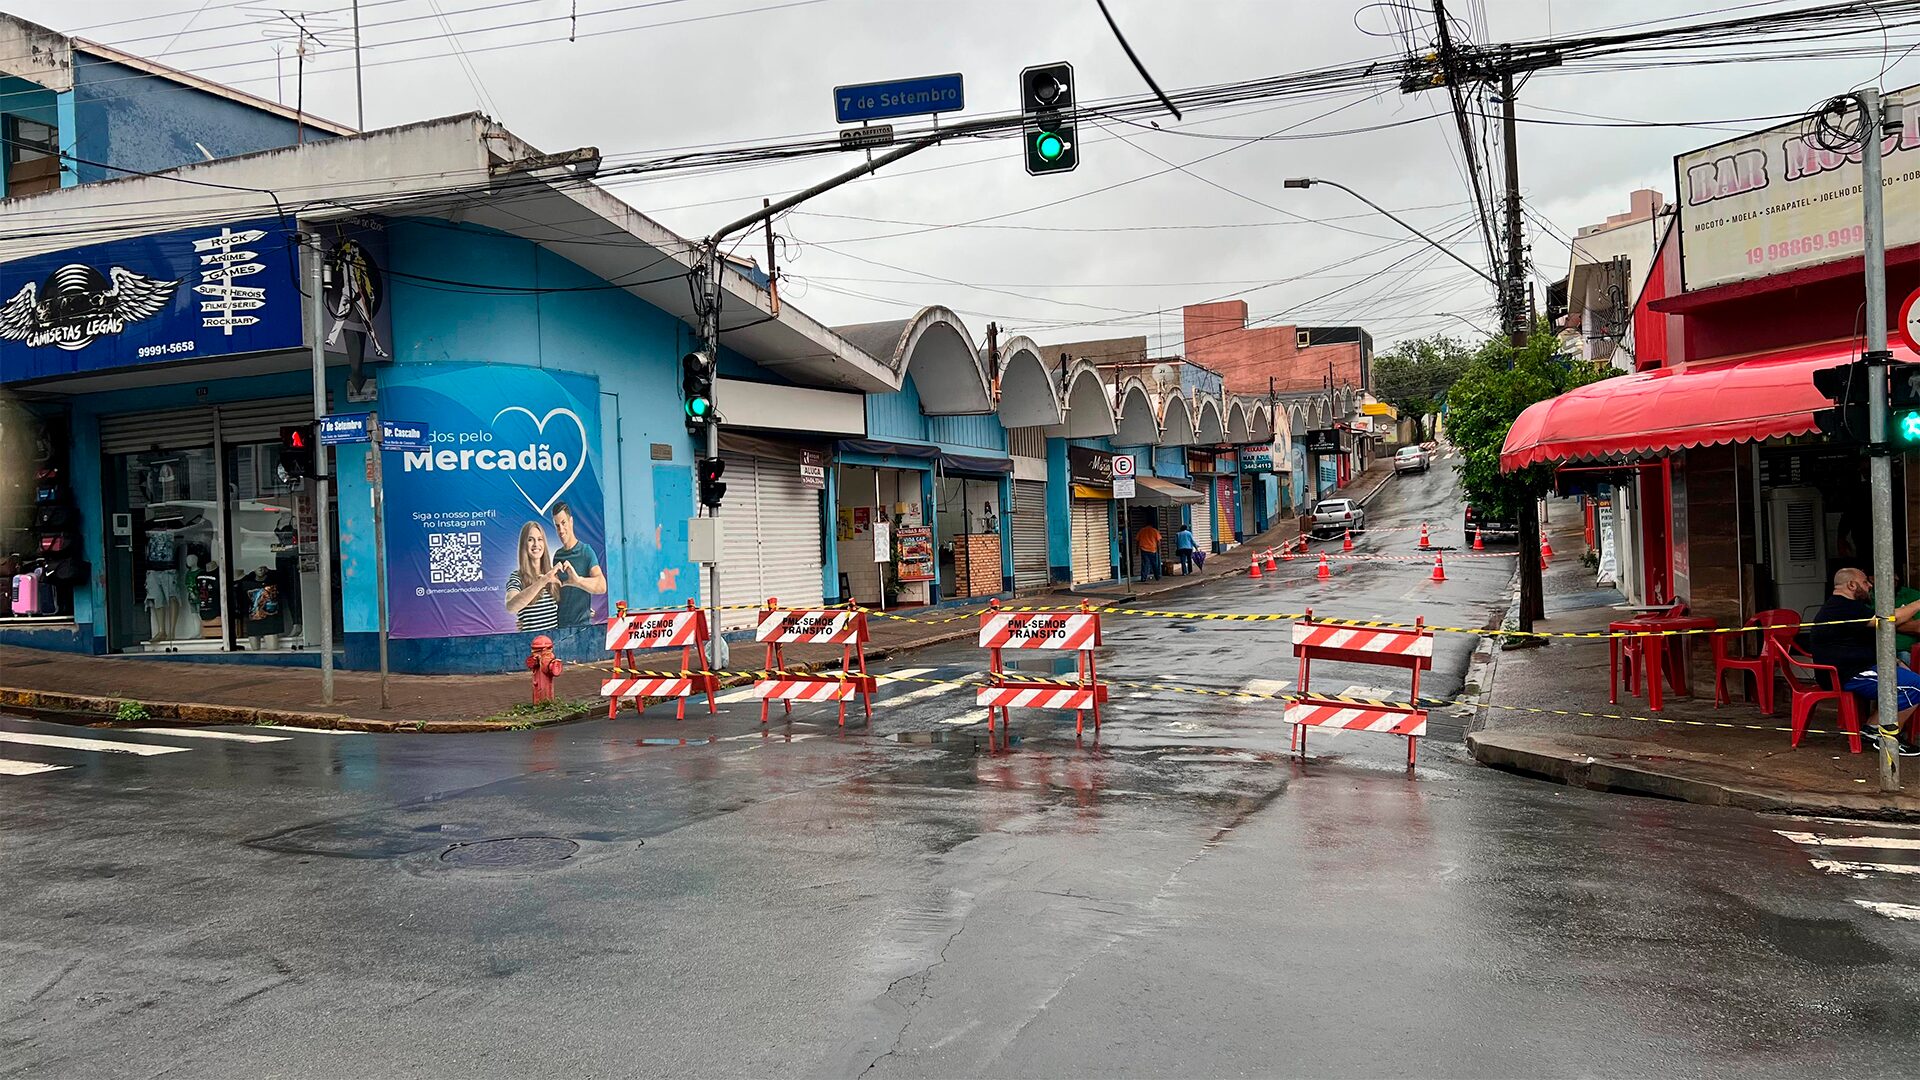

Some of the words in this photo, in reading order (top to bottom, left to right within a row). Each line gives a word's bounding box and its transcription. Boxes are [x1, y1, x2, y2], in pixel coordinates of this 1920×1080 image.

[842, 98, 851, 110] 7
[858, 96, 874, 109] de
[880, 88, 956, 106] Setembro
[1687, 149, 1769, 206] BAR
[1732, 210, 1757, 223] MOELA
[1765, 198, 1811, 215] SARAPATEL
[1820, 188, 1850, 202] JOELHO
[1852, 185, 1862, 194] DE
[212, 234, 247, 246] ROCK
[1745, 247, 1764, 264] 19
[1768, 225, 1862, 260] 98869.999
[210, 253, 246, 262] ANIME
[209, 266, 256, 280] GAMES
[26, 325, 81, 347] CAMISETAS
[86, 317, 123, 336] LEGAIS
[138, 340, 194, 357] 99991-5658
[321, 422, 325, 432] 7
[326, 422, 334, 431] de
[334, 420, 362, 431] Setembro
[394, 428, 420, 438] Cascalho
[429, 430, 455, 443] dos
[460, 430, 493, 444] pelo
[404, 444, 567, 472] Mercadão
[1120, 461, 1126, 470] E
[412, 511, 431, 521] Siga
[472, 510, 496, 519] perfil
[438, 520, 486, 528] Instagram
[629, 620, 673, 629] PML-SEMOB
[782, 617, 833, 626] PML-SEMOB
[1008, 620, 1066, 628] PML-SEMOB
